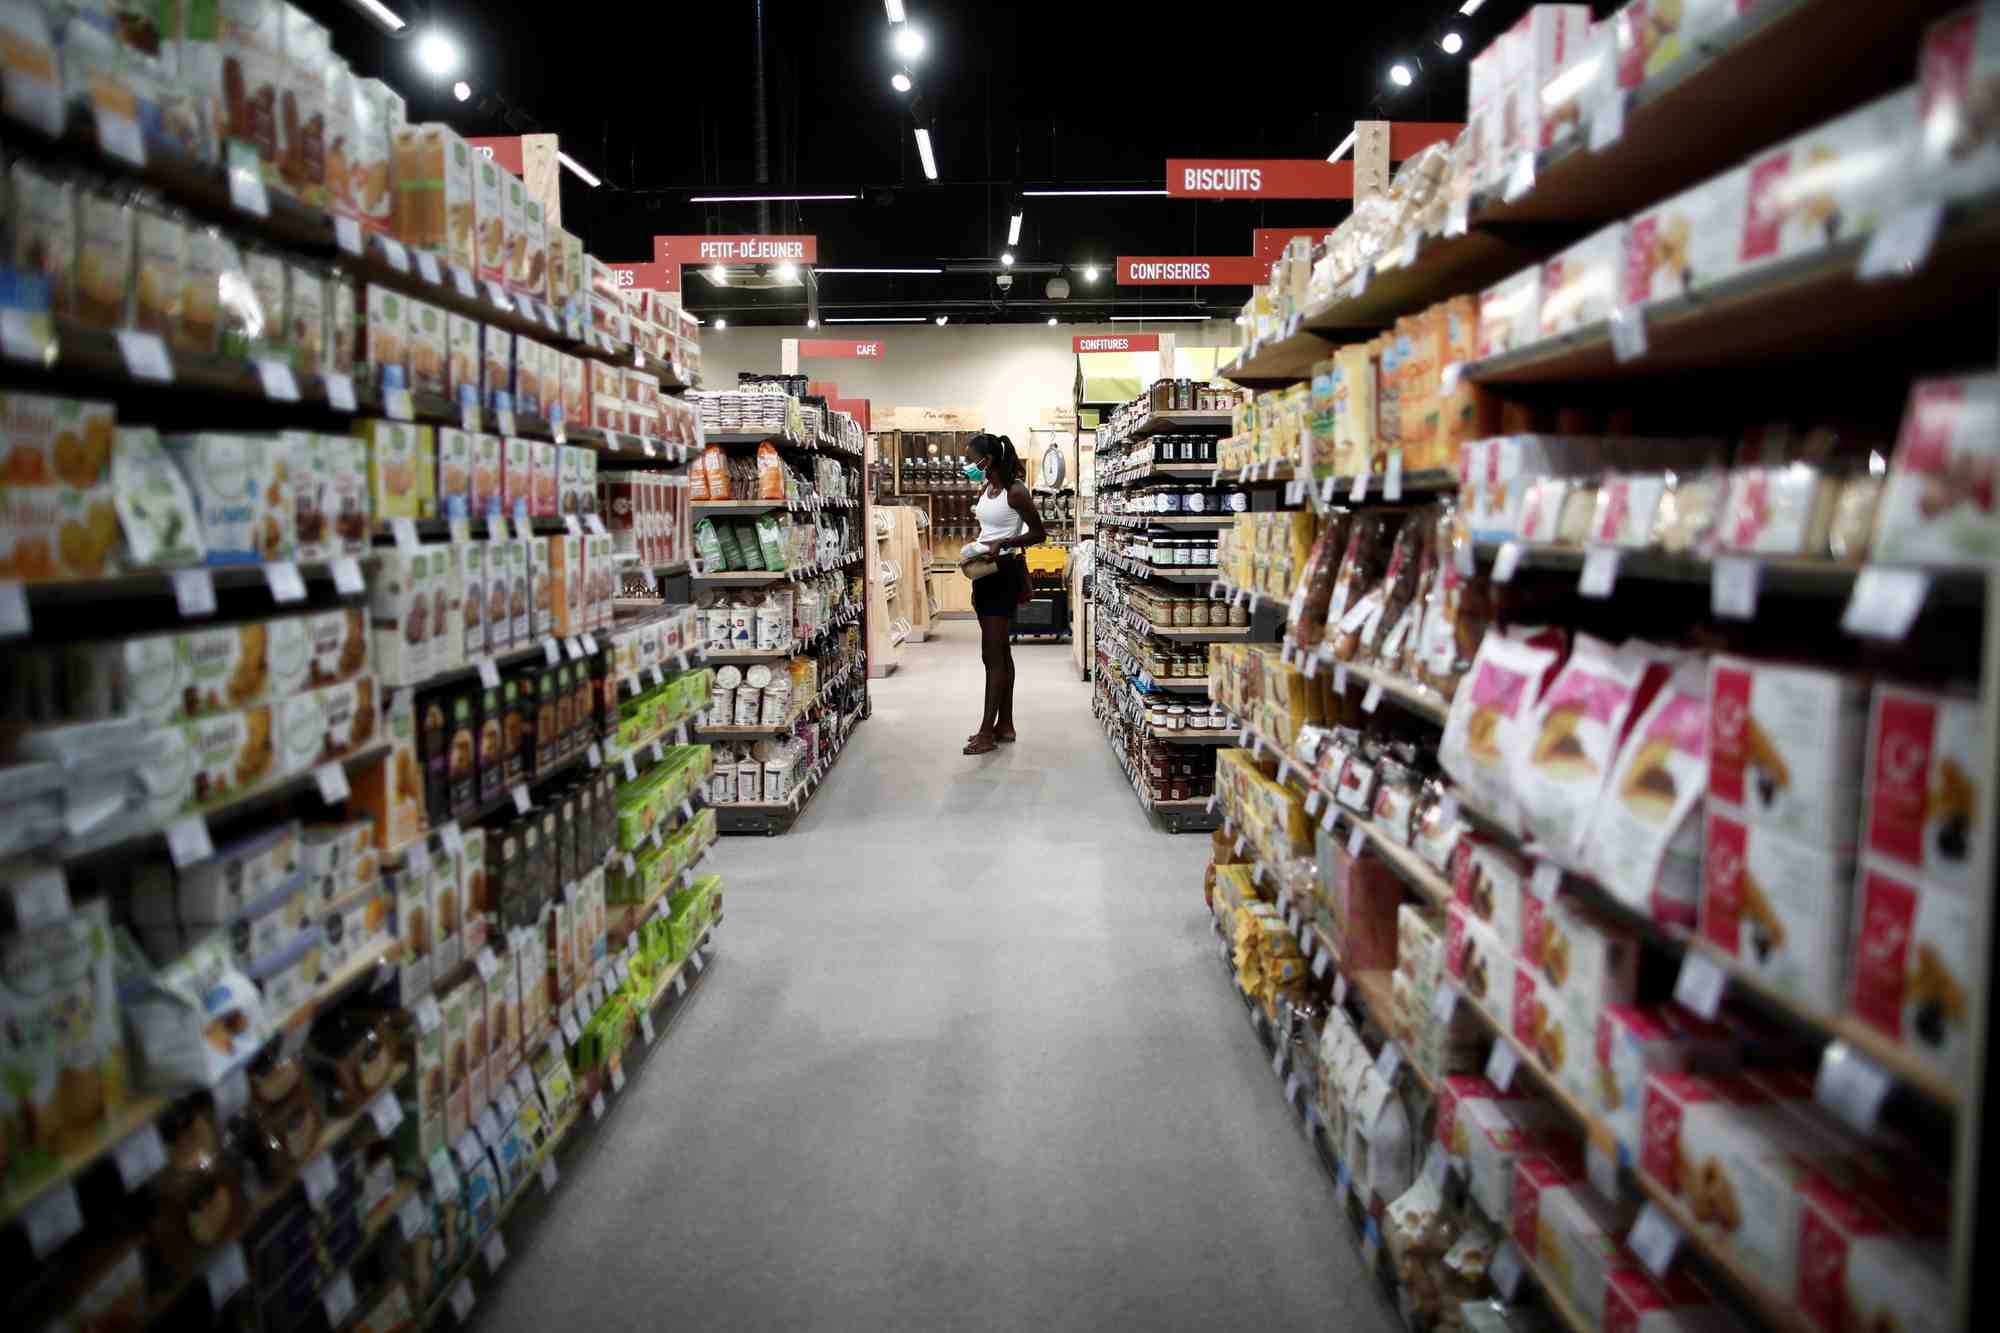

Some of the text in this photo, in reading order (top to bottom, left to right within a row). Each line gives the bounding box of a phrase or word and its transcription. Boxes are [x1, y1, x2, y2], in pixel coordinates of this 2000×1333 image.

[1184, 168, 1261, 191] BISCUITS
[701, 239, 803, 258] PETIT-DÉJEUNER
[1130, 263, 1210, 280] CONFISERIES
[856, 344, 877, 355] CAFÉ
[1080, 338, 1129, 350] CONFITURES
